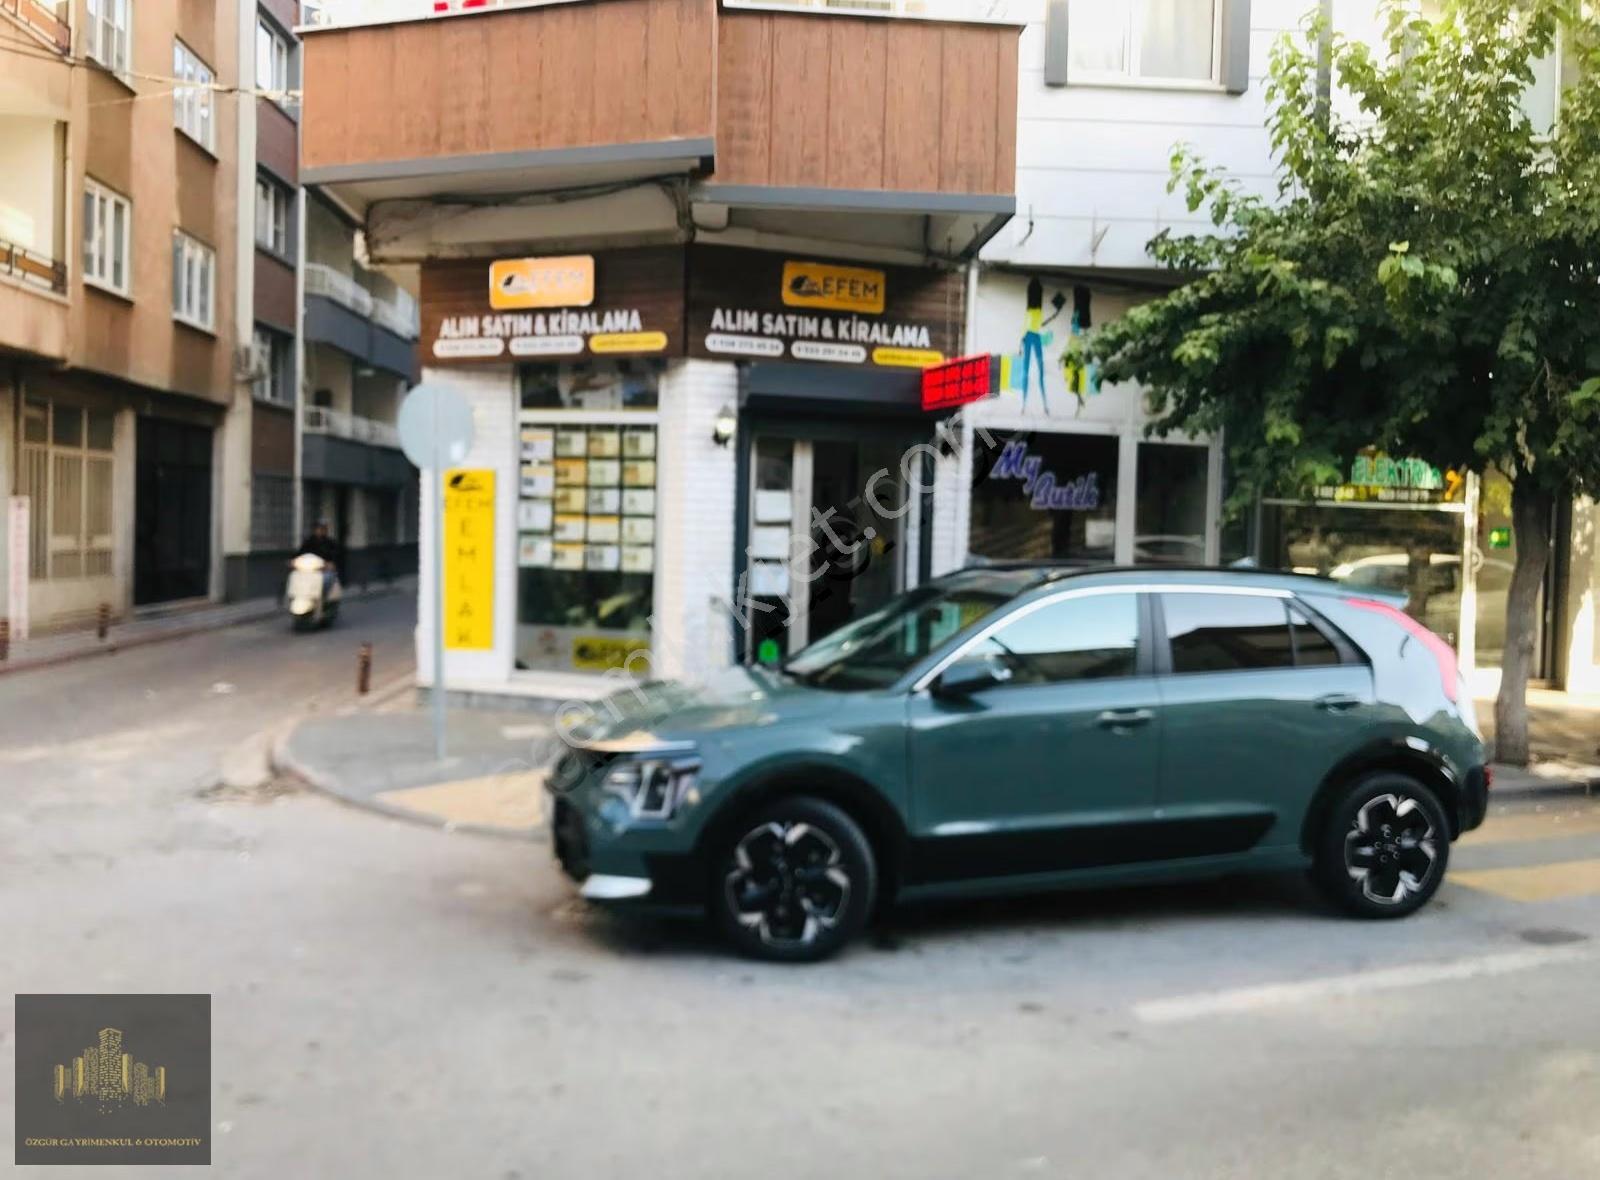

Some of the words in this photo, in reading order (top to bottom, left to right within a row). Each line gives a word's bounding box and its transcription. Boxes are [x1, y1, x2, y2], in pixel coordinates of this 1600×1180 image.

[822, 276, 879, 298] EFEM
[439, 315, 479, 338] ALIM
[481, 313, 533, 338] SATIM
[534, 312, 547, 336] &
[548, 308, 642, 336] KİRALAMA
[710, 307, 758, 333] ALIM
[762, 312, 819, 339] SATIM
[820, 317, 835, 339] &
[837, 314, 931, 348] KİRALAMA
[988, 440, 1042, 495] My
[443, 496, 492, 512] EFEM
